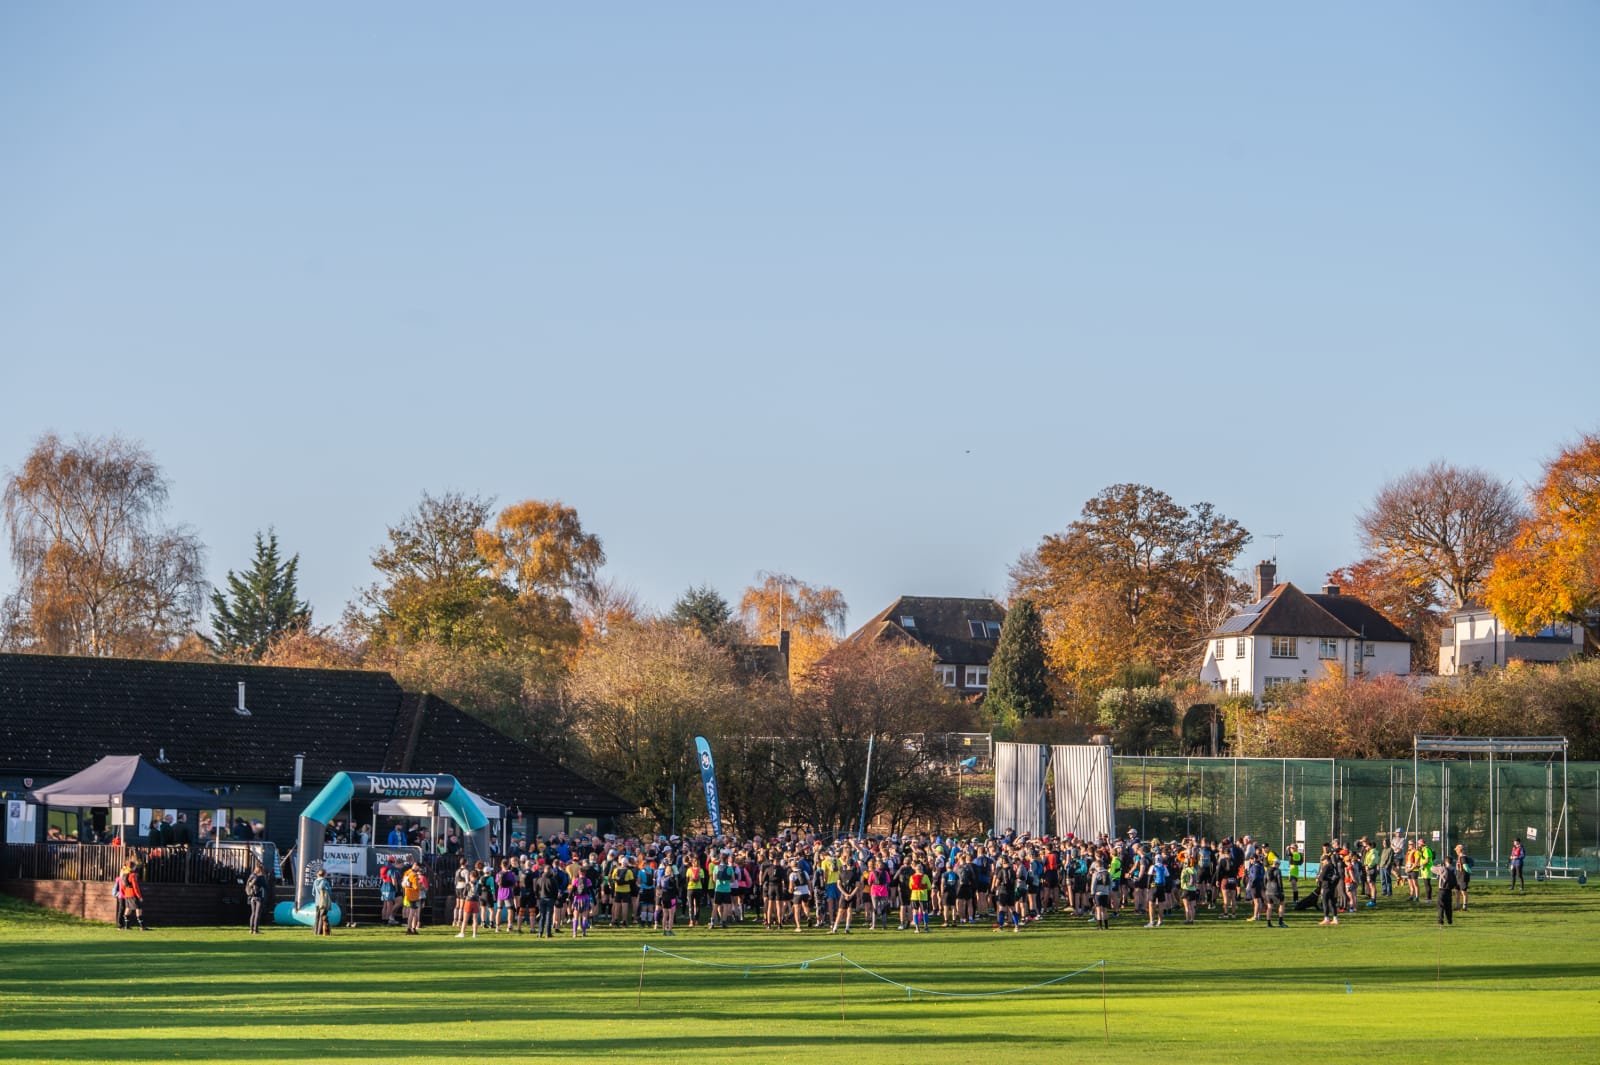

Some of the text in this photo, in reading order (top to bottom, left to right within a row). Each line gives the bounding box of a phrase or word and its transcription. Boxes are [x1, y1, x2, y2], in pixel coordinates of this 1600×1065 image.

[367, 776, 437, 795] RUNAWAY
[385, 789, 423, 797] RACING
[322, 852, 360, 864] UNAWAY
